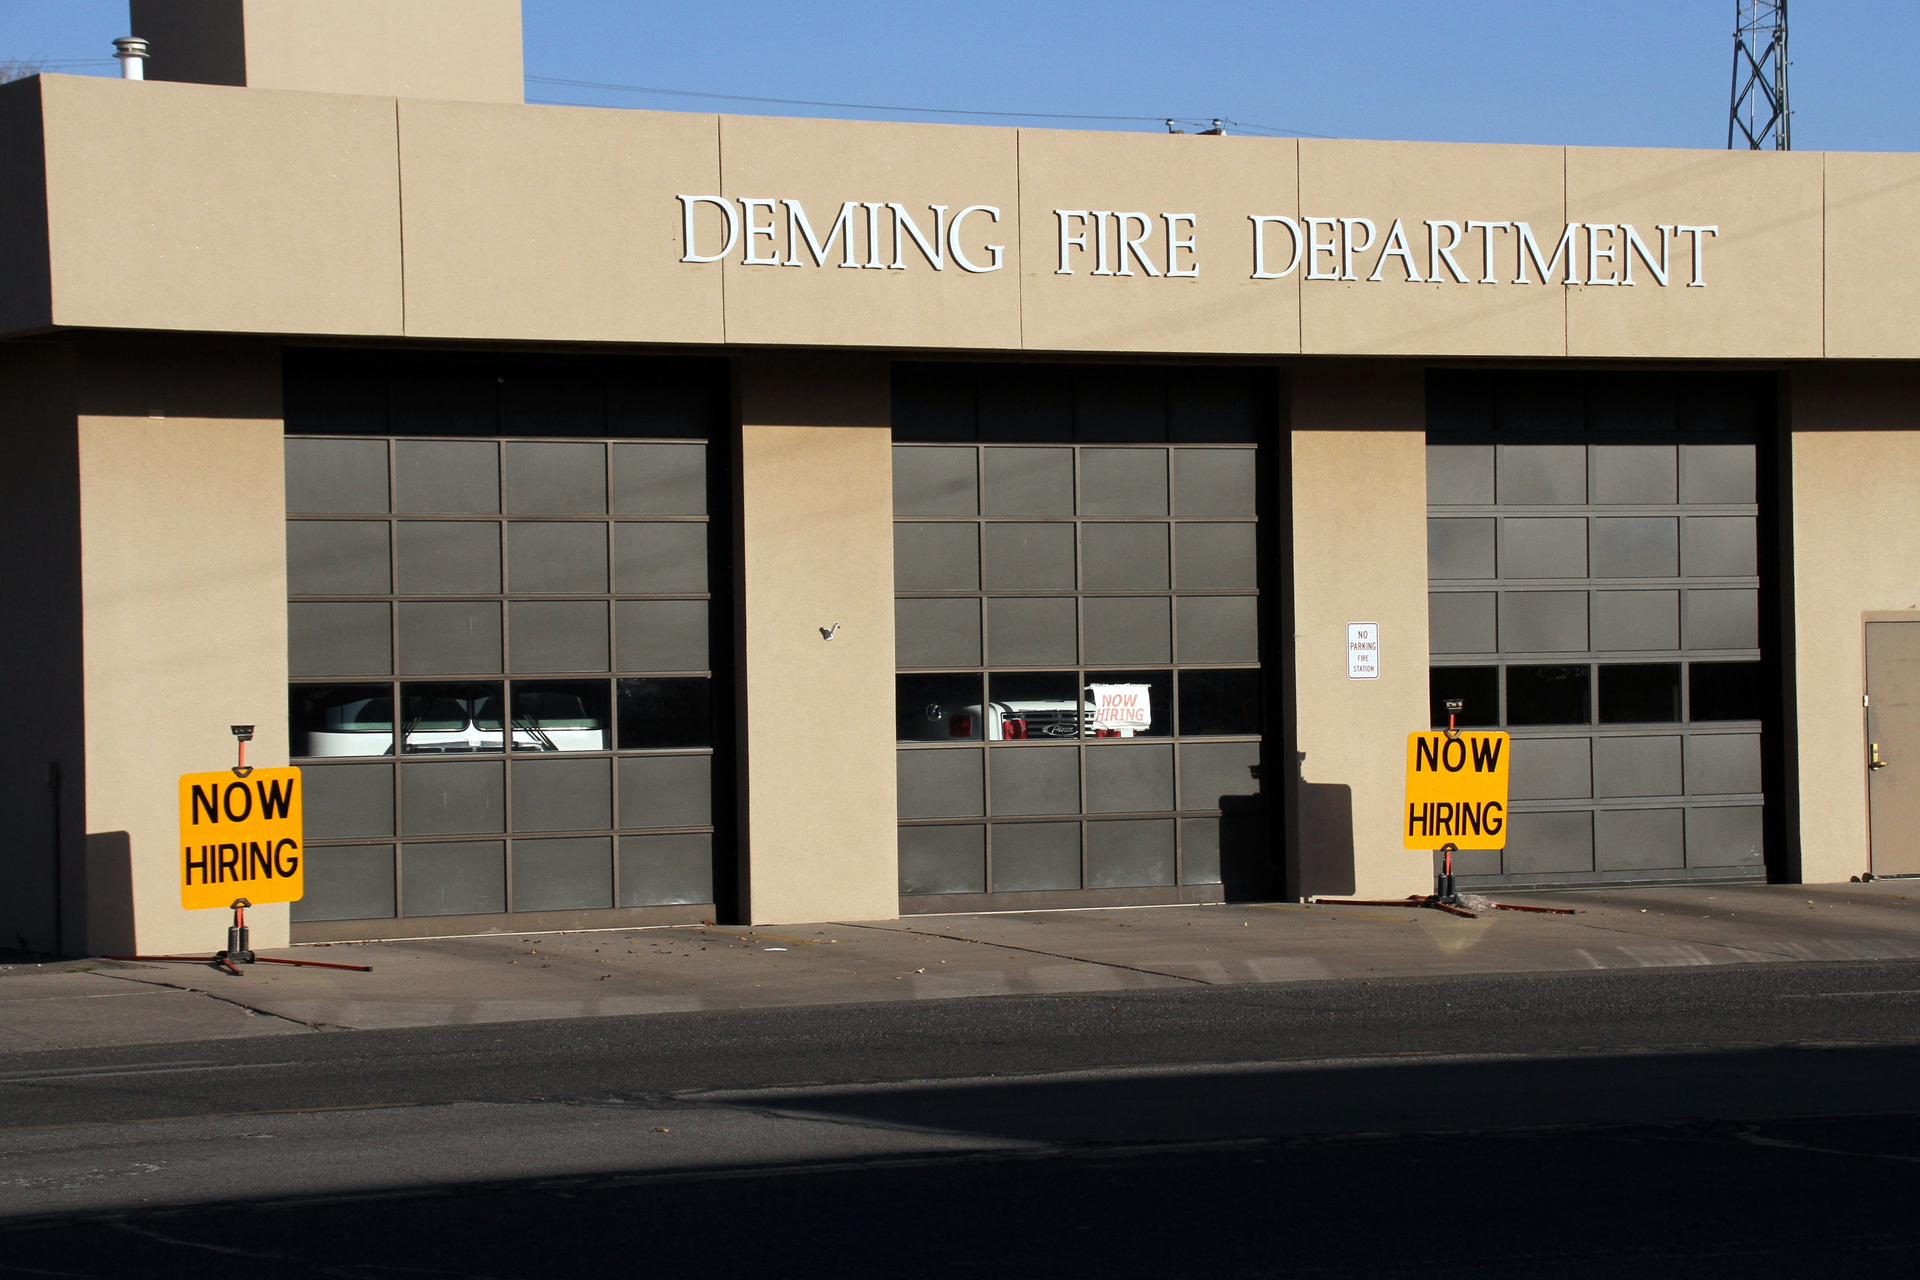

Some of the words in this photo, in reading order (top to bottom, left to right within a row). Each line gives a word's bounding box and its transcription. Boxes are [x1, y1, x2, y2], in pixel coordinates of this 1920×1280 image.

[675, 194, 1004, 273] DEMING
[1053, 208, 1200, 278] FIRE
[1247, 214, 1719, 288] DEPARTMENT
[1350, 642, 1376, 650] PARKING
[1358, 630, 1368, 639] NO
[1096, 708, 1144, 721] HIRING
[1102, 694, 1138, 707] NOW
[1416, 737, 1502, 772] NOW
[192, 778, 294, 825] NOW
[1409, 801, 1503, 836] HIRING
[185, 838, 298, 885] HIRING
